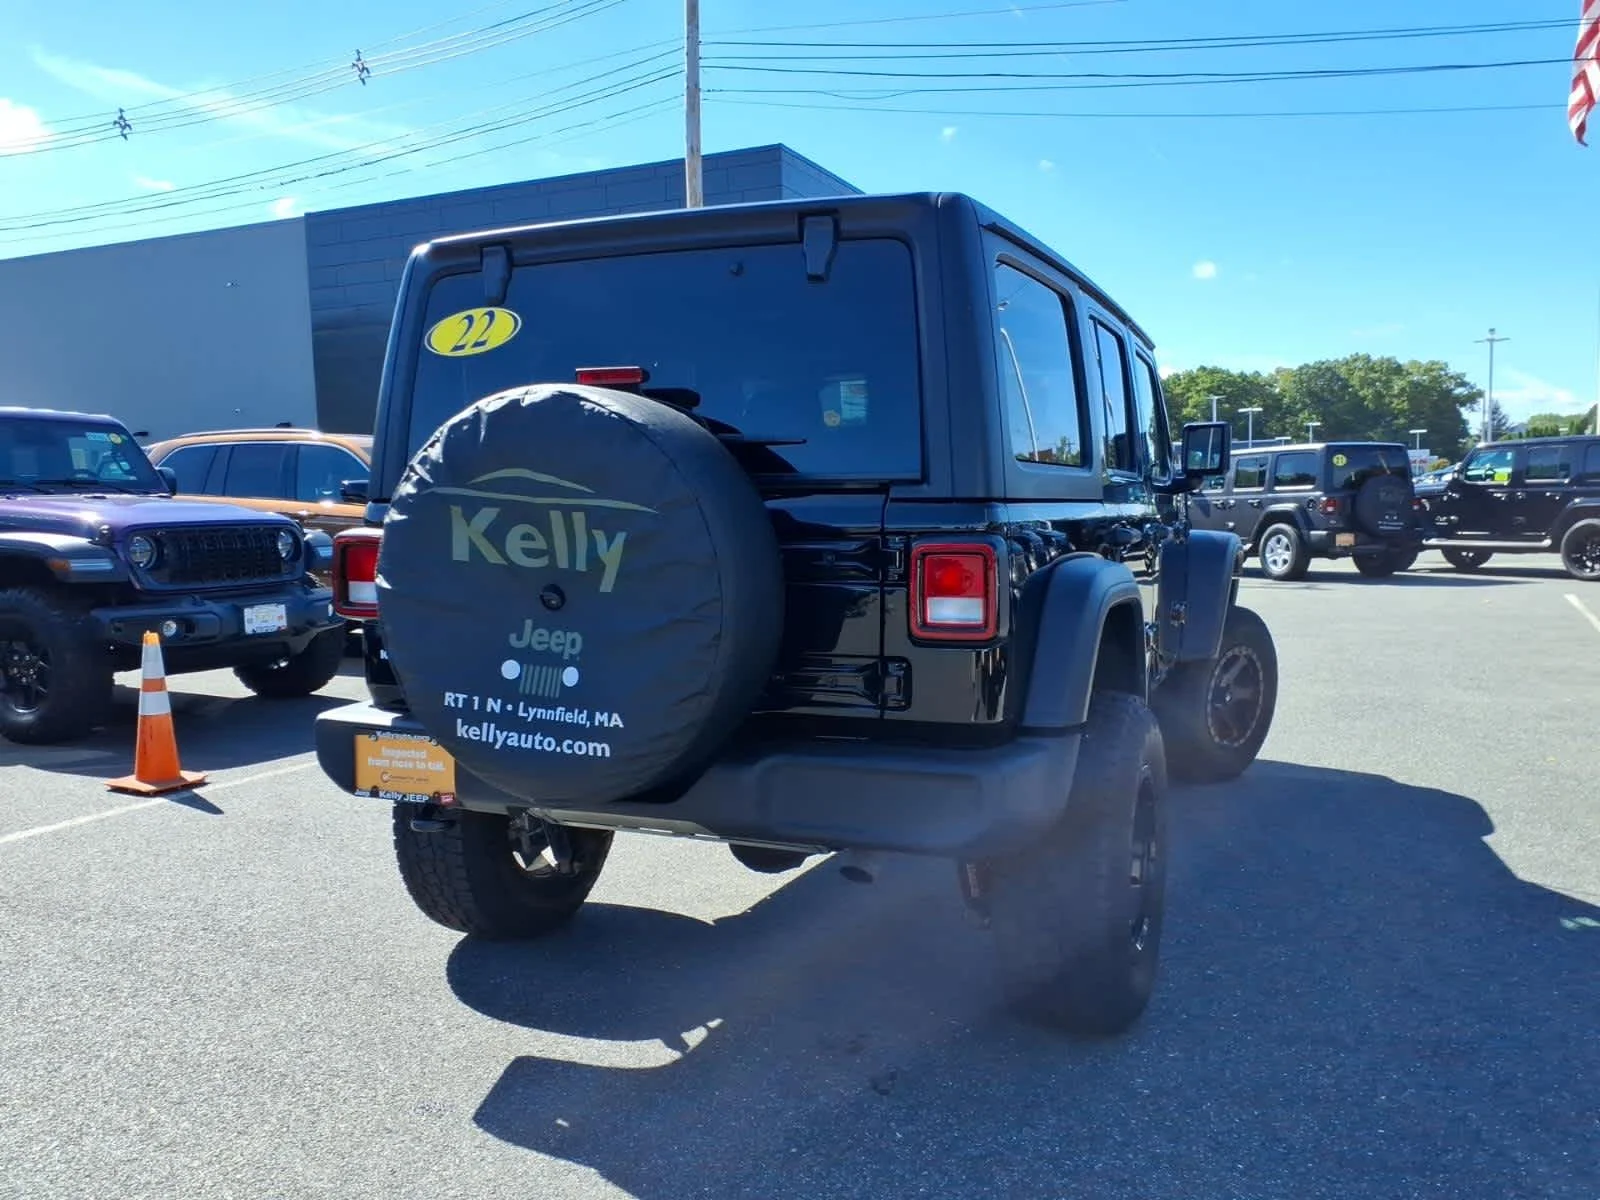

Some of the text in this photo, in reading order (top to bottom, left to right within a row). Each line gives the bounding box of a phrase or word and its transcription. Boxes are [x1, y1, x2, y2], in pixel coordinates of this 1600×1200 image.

[449, 310, 496, 352] 22
[450, 504, 628, 592] Kelly
[509, 619, 583, 660] Jeep
[444, 691, 624, 728] RT 1 N Lynnfield, MA
[456, 718, 611, 758] kellyauto.com
[379, 790, 402, 801] Kelly
[403, 793, 430, 803] JEEP
